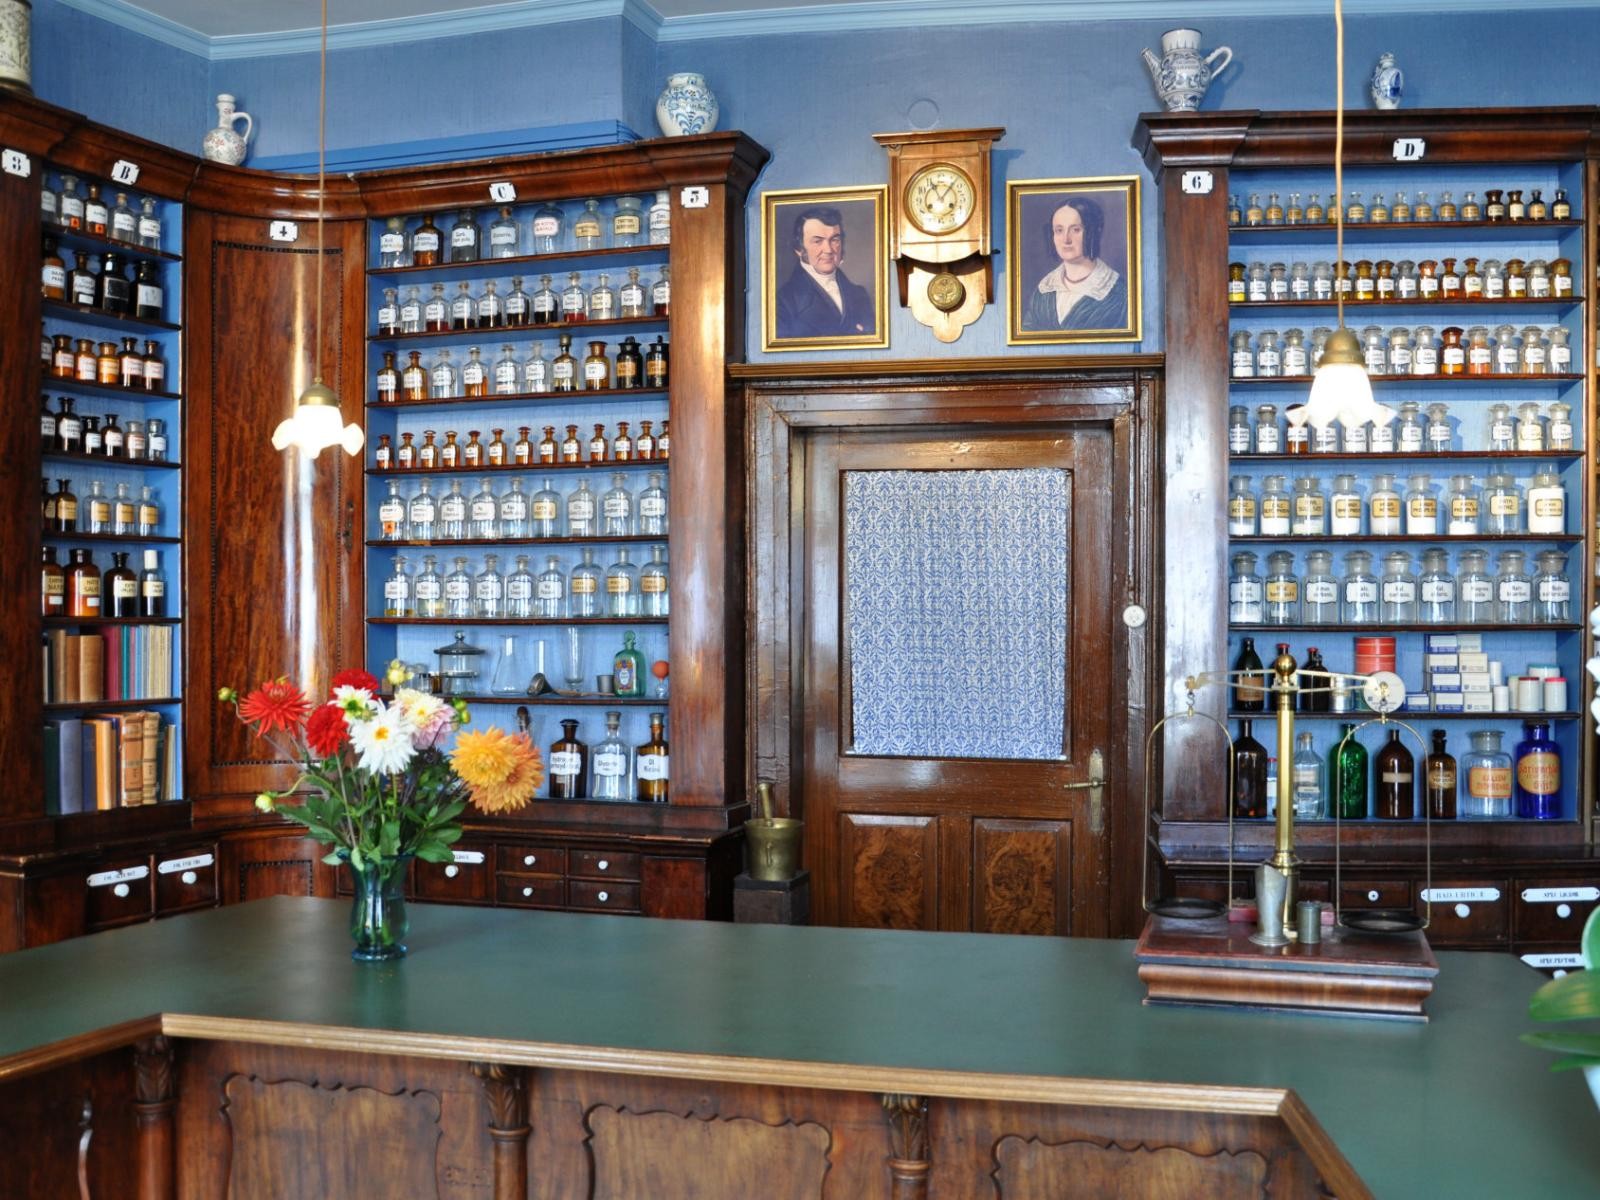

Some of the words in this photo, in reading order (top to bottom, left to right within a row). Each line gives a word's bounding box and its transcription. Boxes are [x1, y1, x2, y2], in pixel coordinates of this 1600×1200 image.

[1404, 143, 1415, 157] D
[12, 156, 21, 171] 3
[119, 165, 131, 180] B
[1192, 175, 1201, 190] 6
[497, 186, 506, 199] C
[690, 190, 699, 203] 5
[279, 225, 288, 237] 4
